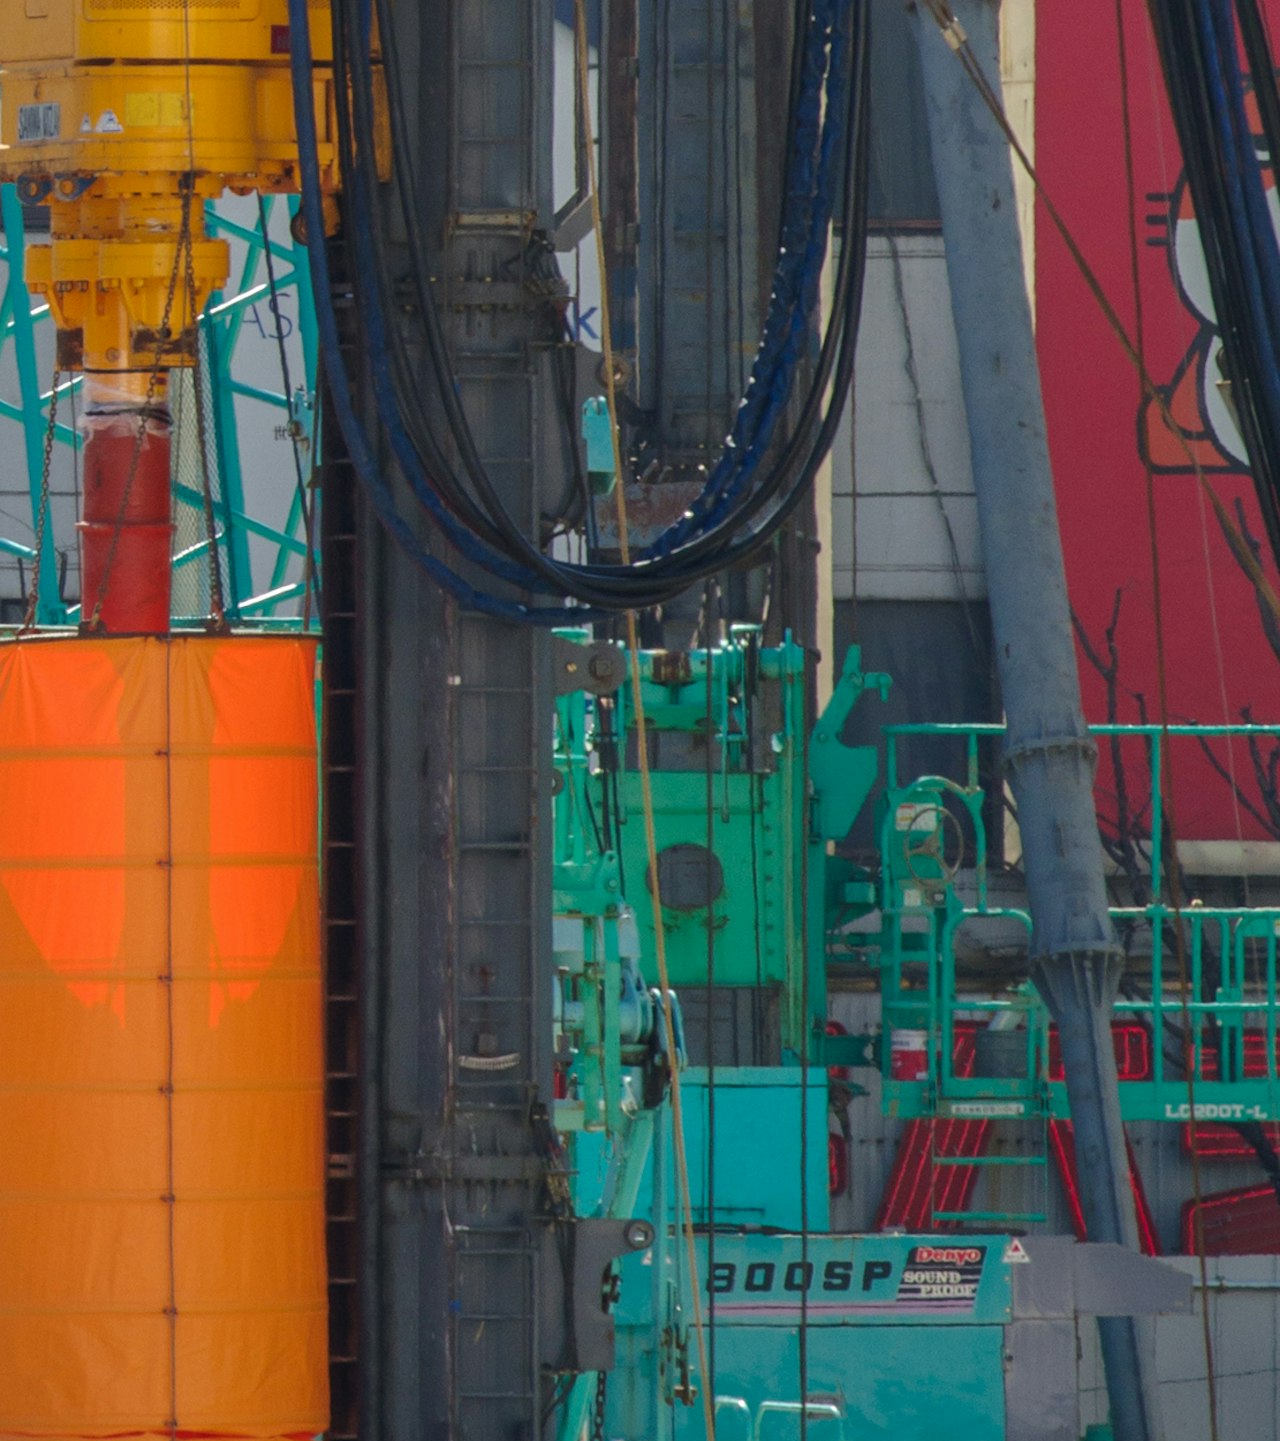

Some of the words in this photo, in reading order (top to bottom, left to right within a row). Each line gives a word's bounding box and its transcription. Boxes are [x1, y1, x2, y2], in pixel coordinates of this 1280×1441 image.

[916, 1247, 981, 1265] Denyo
[705, 1260, 893, 1293] 800SP
[903, 1270, 961, 1284] SOUND
[920, 1284, 977, 1298] PROOF
